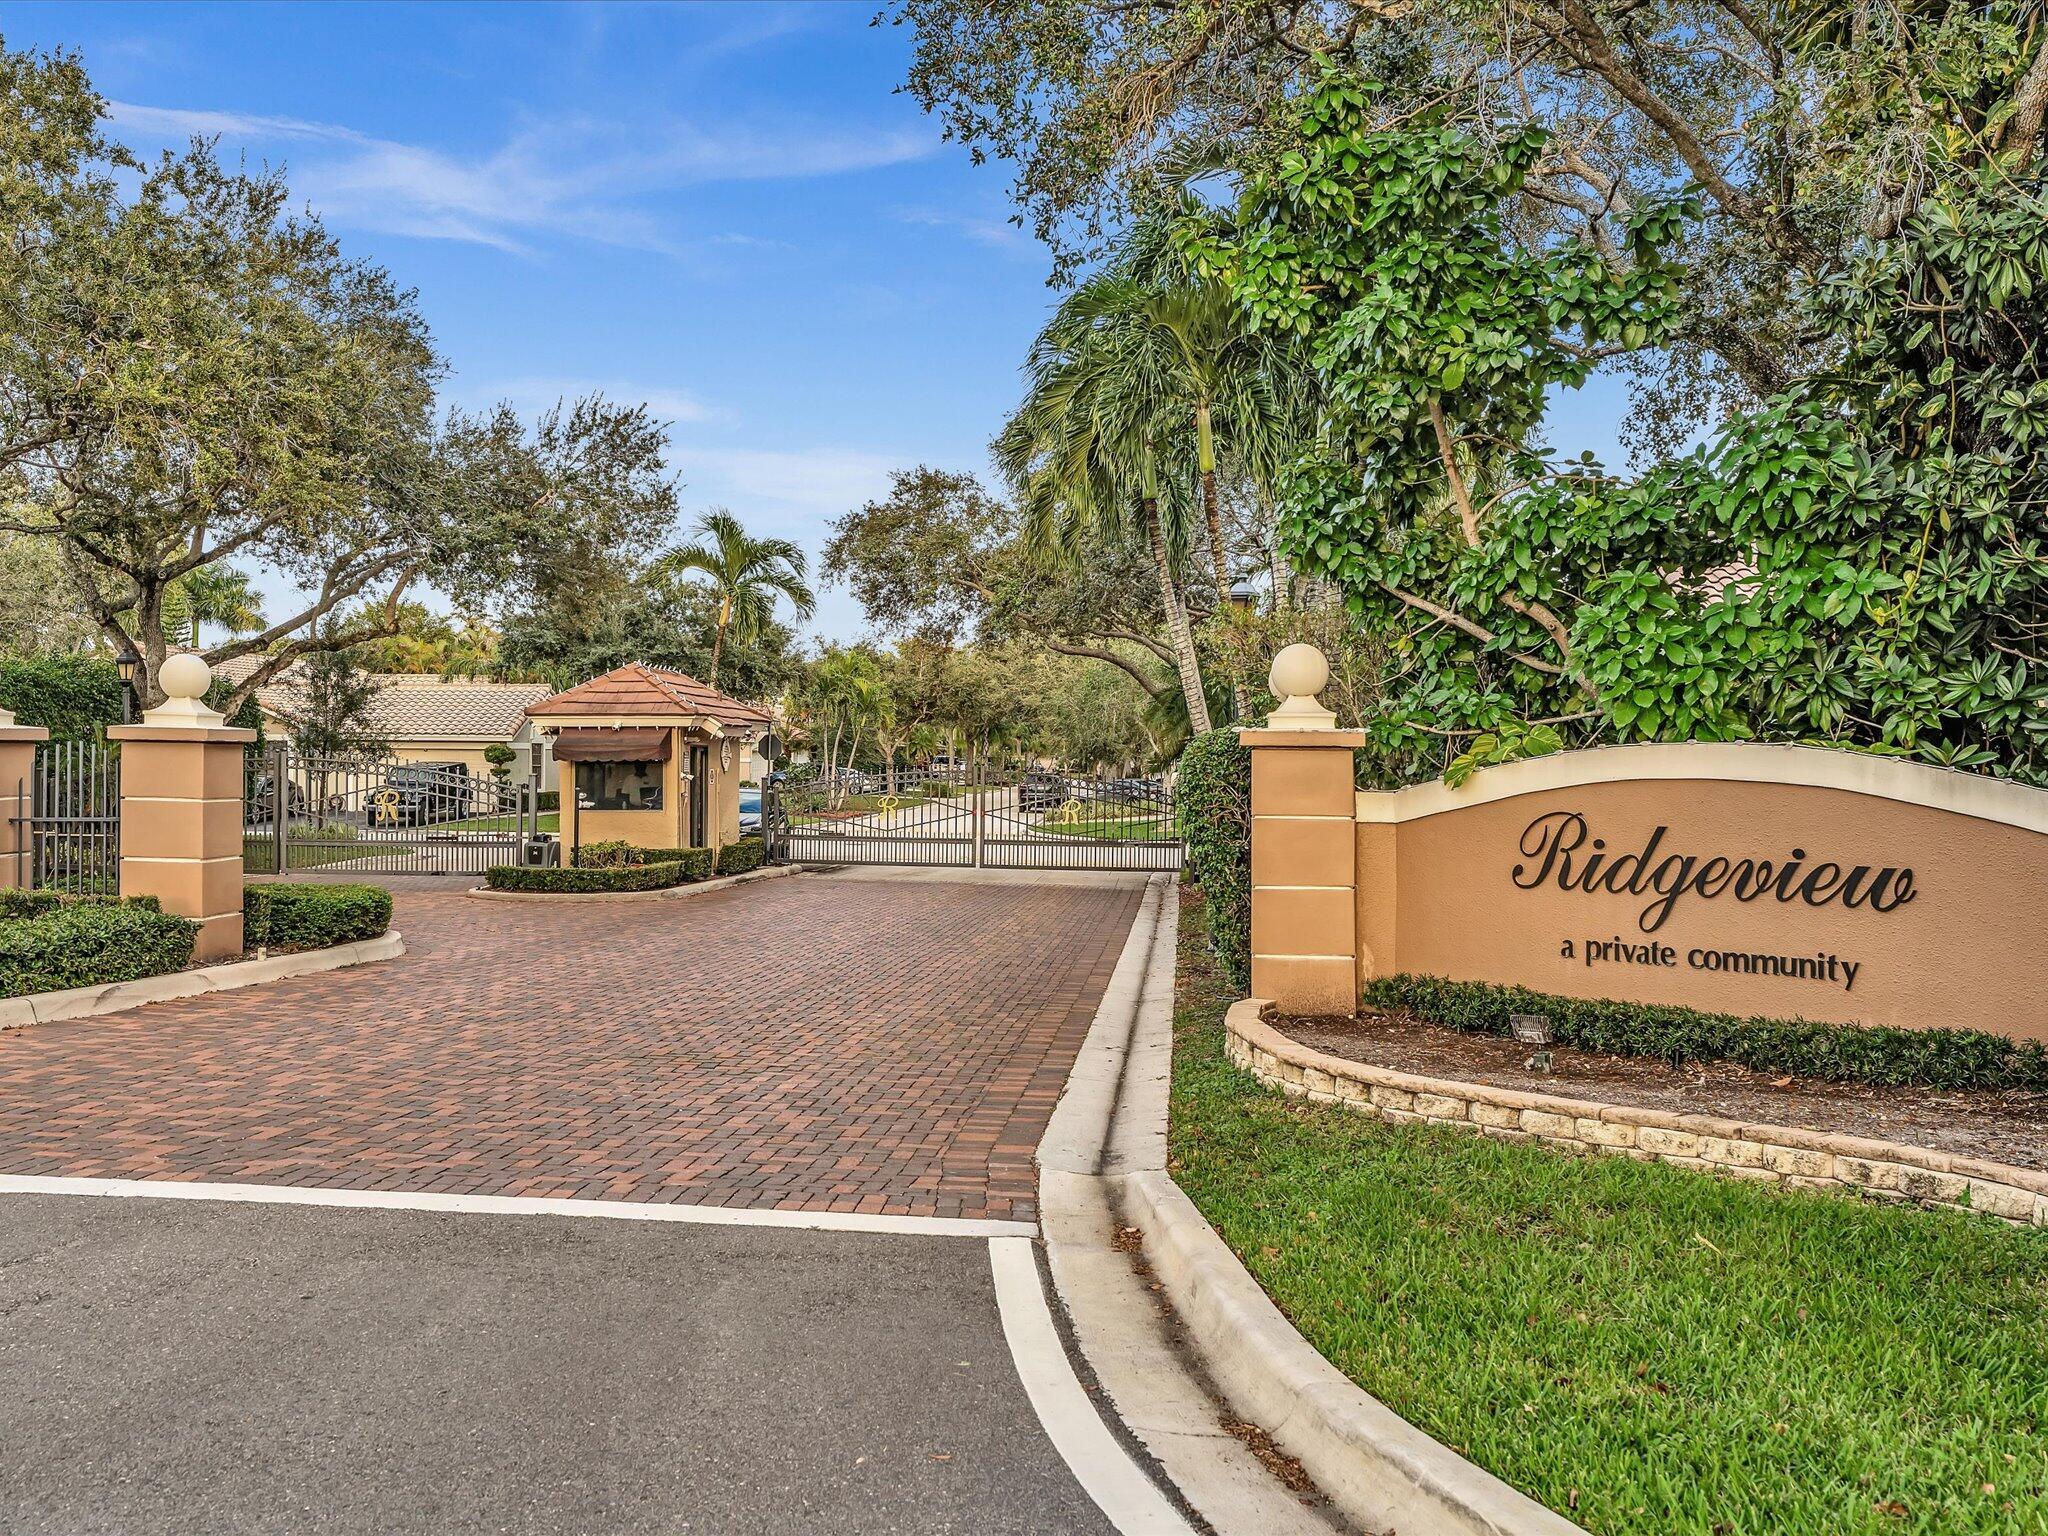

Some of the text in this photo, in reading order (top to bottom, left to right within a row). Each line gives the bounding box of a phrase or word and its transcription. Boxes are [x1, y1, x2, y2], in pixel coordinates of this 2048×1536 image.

[1512, 811, 1917, 933] Ridgeview
[1560, 935, 1860, 992] a private community
